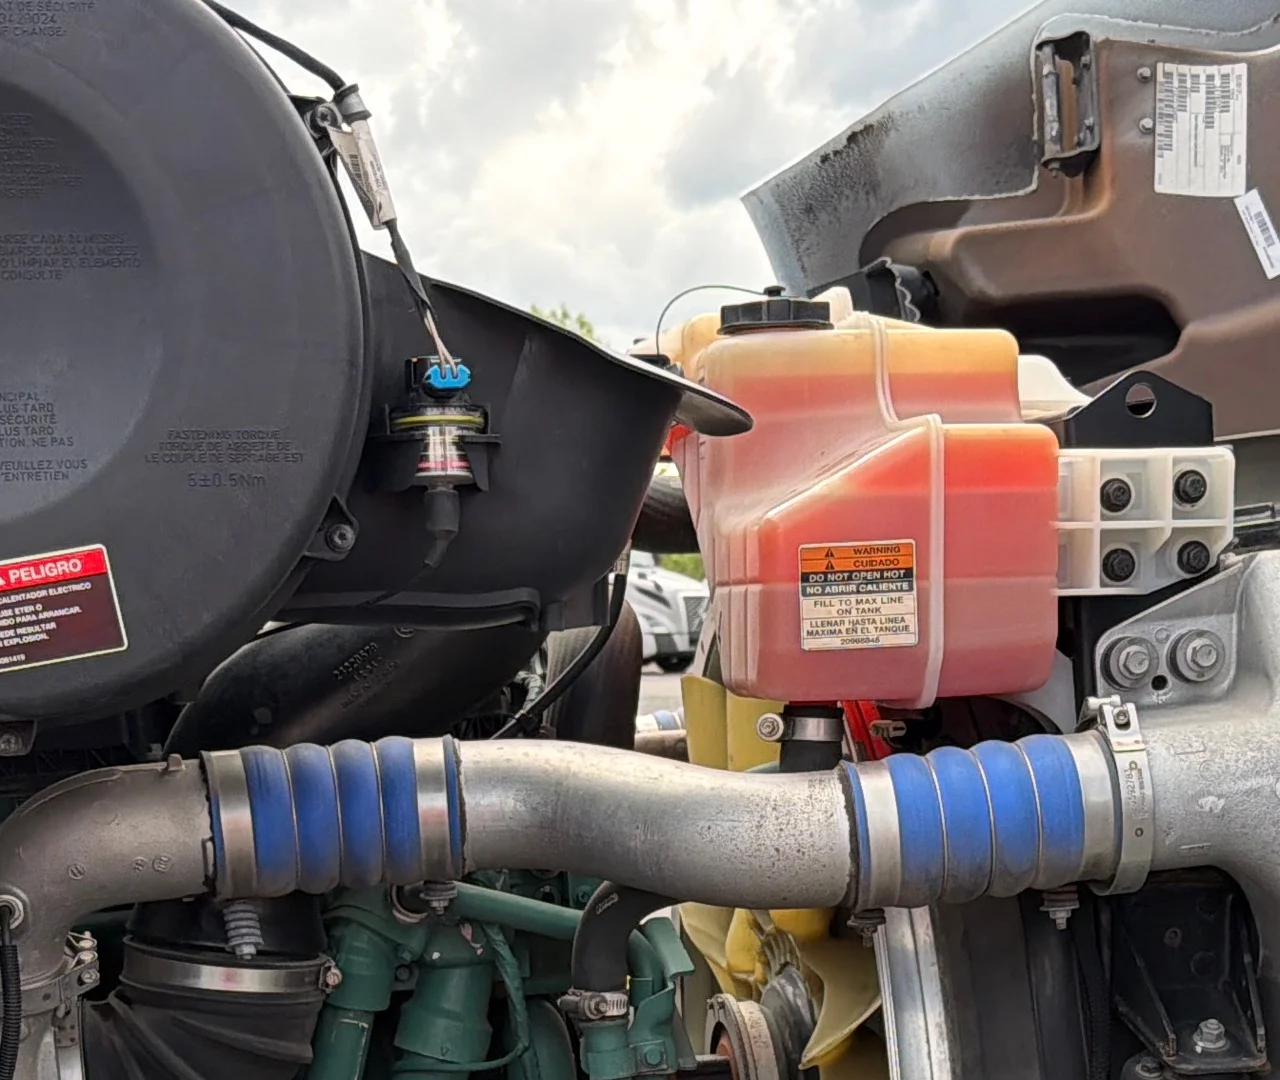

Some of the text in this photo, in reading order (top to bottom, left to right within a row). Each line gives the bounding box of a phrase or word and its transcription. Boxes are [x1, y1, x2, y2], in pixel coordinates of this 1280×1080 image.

[24, 403, 54, 412] TARD
[32, 438, 48, 447] NE
[51, 436, 74, 447] PAS
[56, 458, 88, 469] VOUS
[853, 546, 901, 556] WARNING
[853, 558, 900, 568] CUIDADO
[8, 558, 83, 583] PELIGRO
[809, 569, 906, 582] DO NOT OPEN HOT
[48, 582, 92, 596] ELECTRICO
[806, 581, 909, 595] NO ABRIR CALIENTE
[813, 596, 904, 608] FILL TO MAX LINE
[14, 605, 35, 615] ETER
[35, 603, 43, 611] O
[15, 614, 38, 624] PARA
[38, 605, 82, 620] ARRANCAR.
[836, 606, 882, 615] ON TANK
[810, 616, 906, 628] LLENAR HASTA LINEA
[16, 622, 57, 635] RESULTAR
[806, 624, 911, 637] MAXIMA EN EL TANQUE
[4, 633, 50, 647] EXPLOSION.
